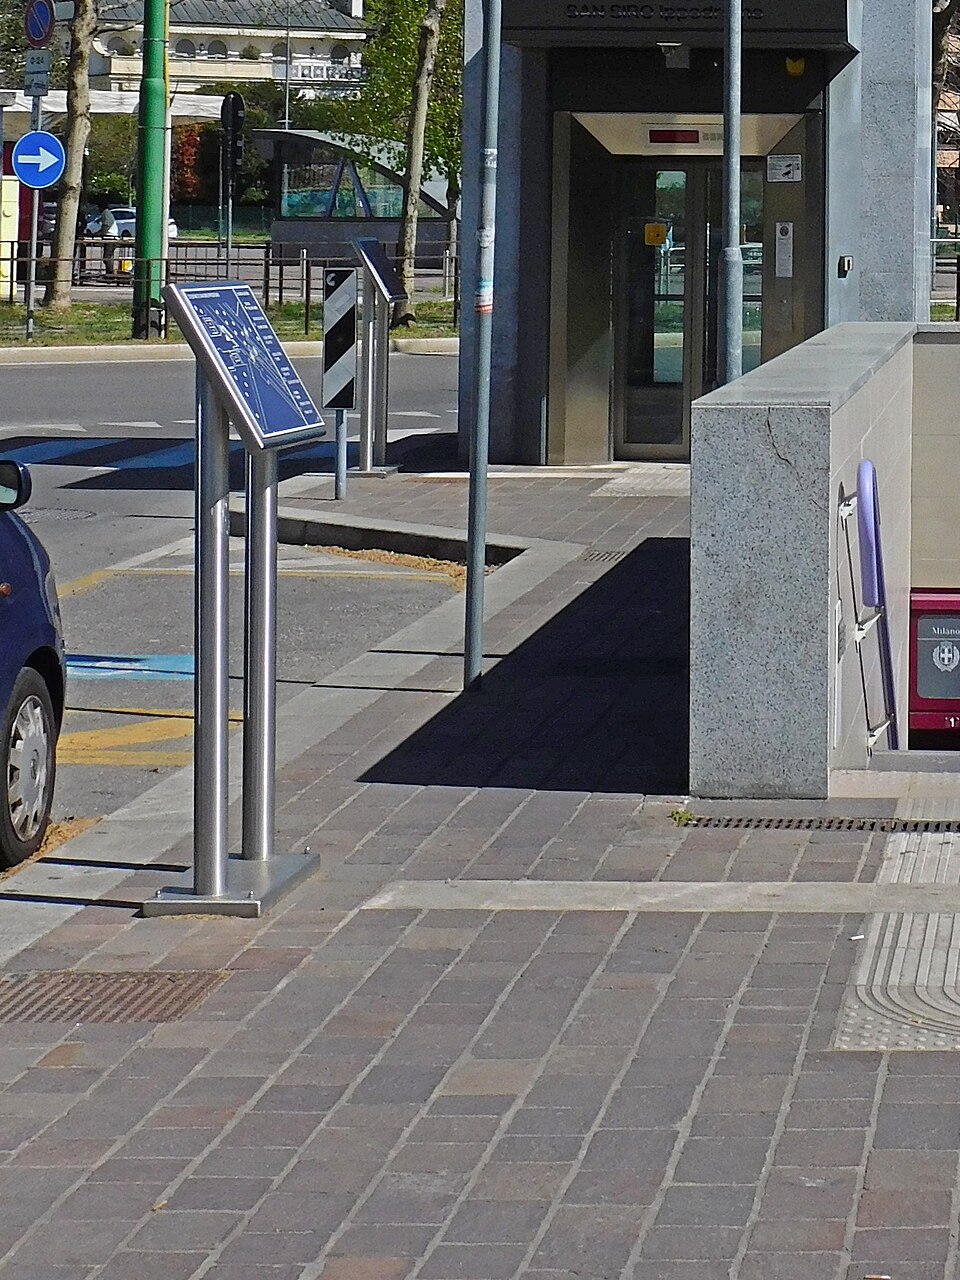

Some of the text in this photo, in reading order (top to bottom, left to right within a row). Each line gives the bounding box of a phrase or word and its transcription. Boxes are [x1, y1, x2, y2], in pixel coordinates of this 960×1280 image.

[566, 4, 605, 20] SAN
[609, 4, 654, 20] SIRO
[932, 626, 960, 635] Milano
